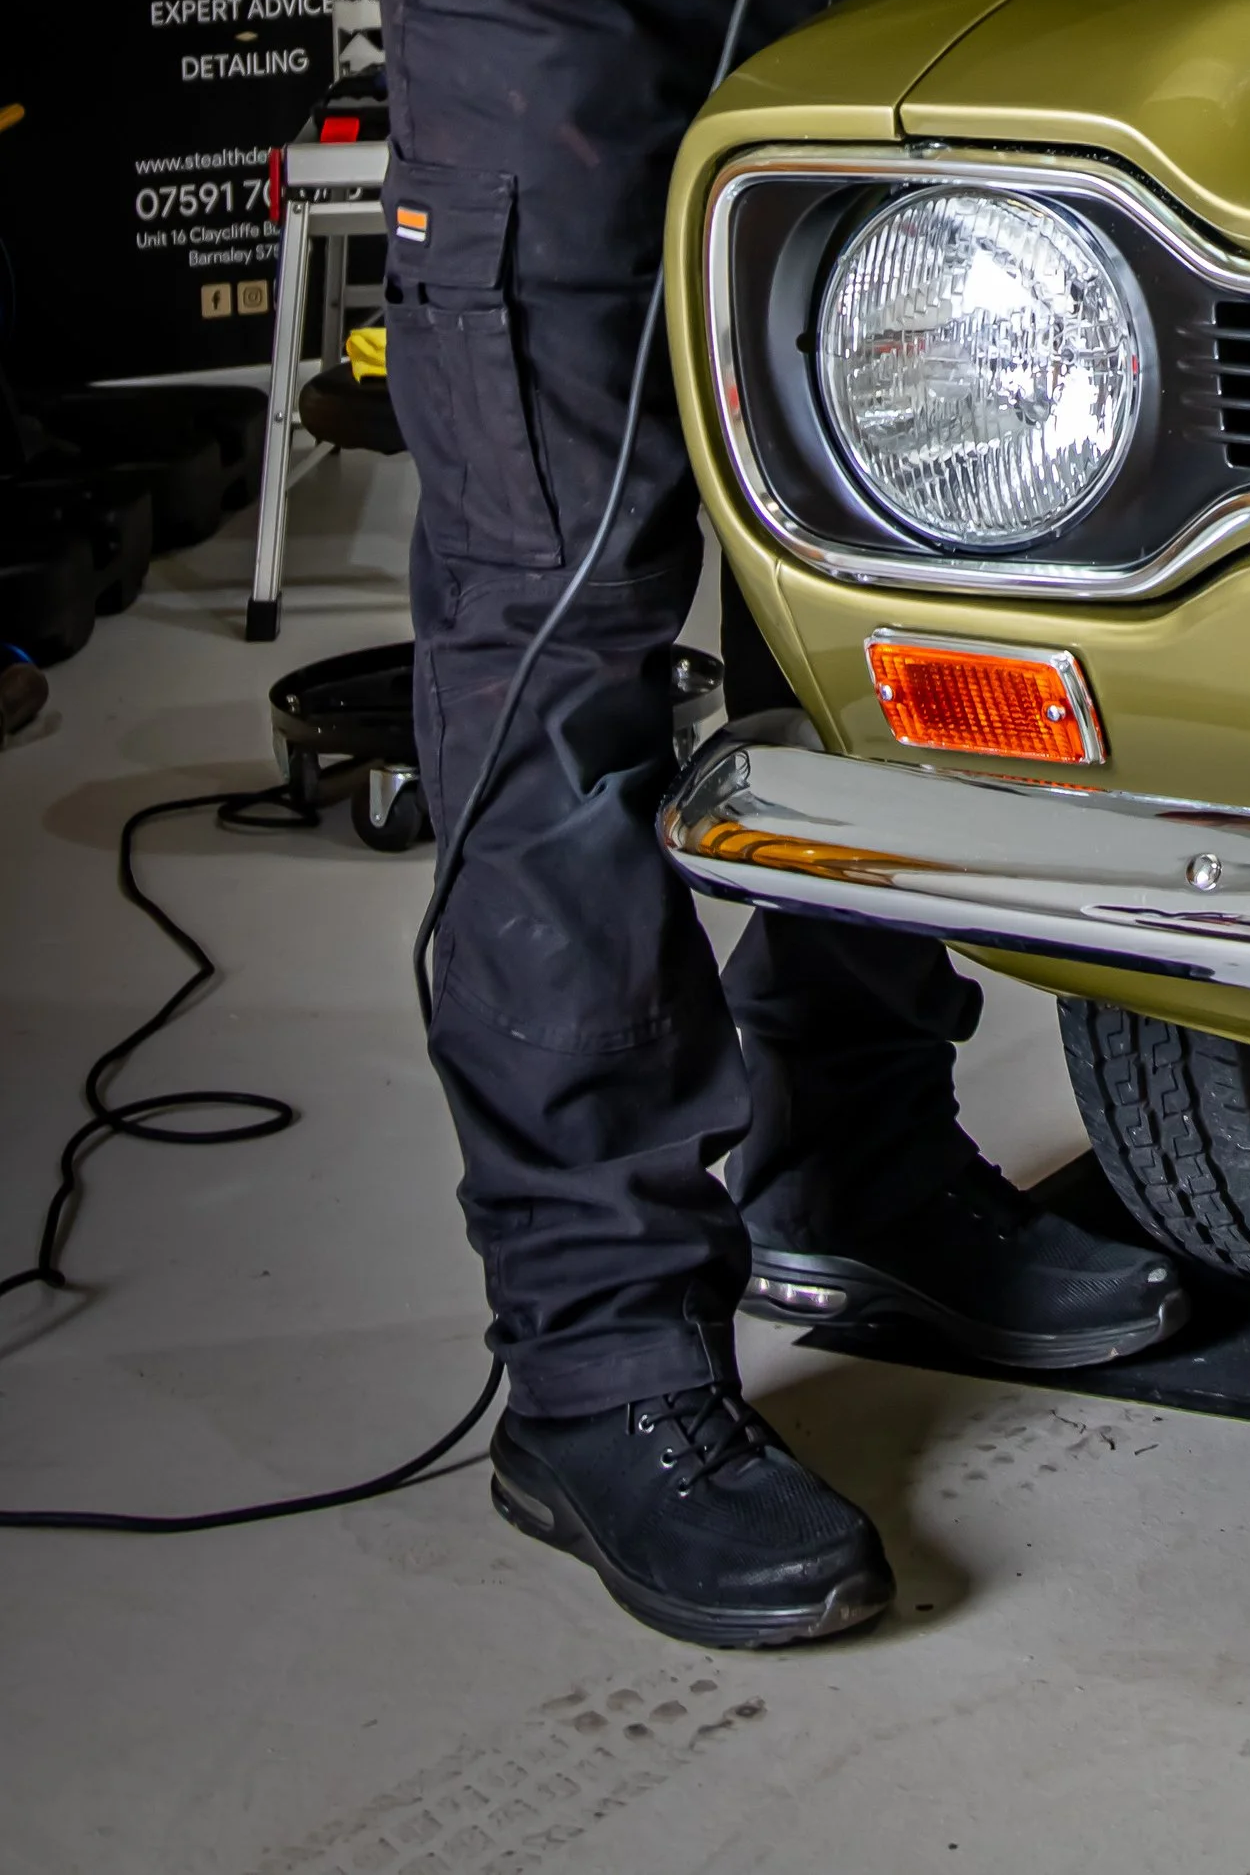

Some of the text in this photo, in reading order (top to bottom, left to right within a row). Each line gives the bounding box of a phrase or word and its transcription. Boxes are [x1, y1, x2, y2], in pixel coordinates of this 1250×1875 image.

[181, 49, 309, 81] DETAILING
[135, 179, 234, 221] 07591
[136, 230, 168, 249] Unit
[170, 228, 187, 245] 16
[188, 222, 260, 245] Claycliffe
[187, 246, 252, 268] Barnsley
